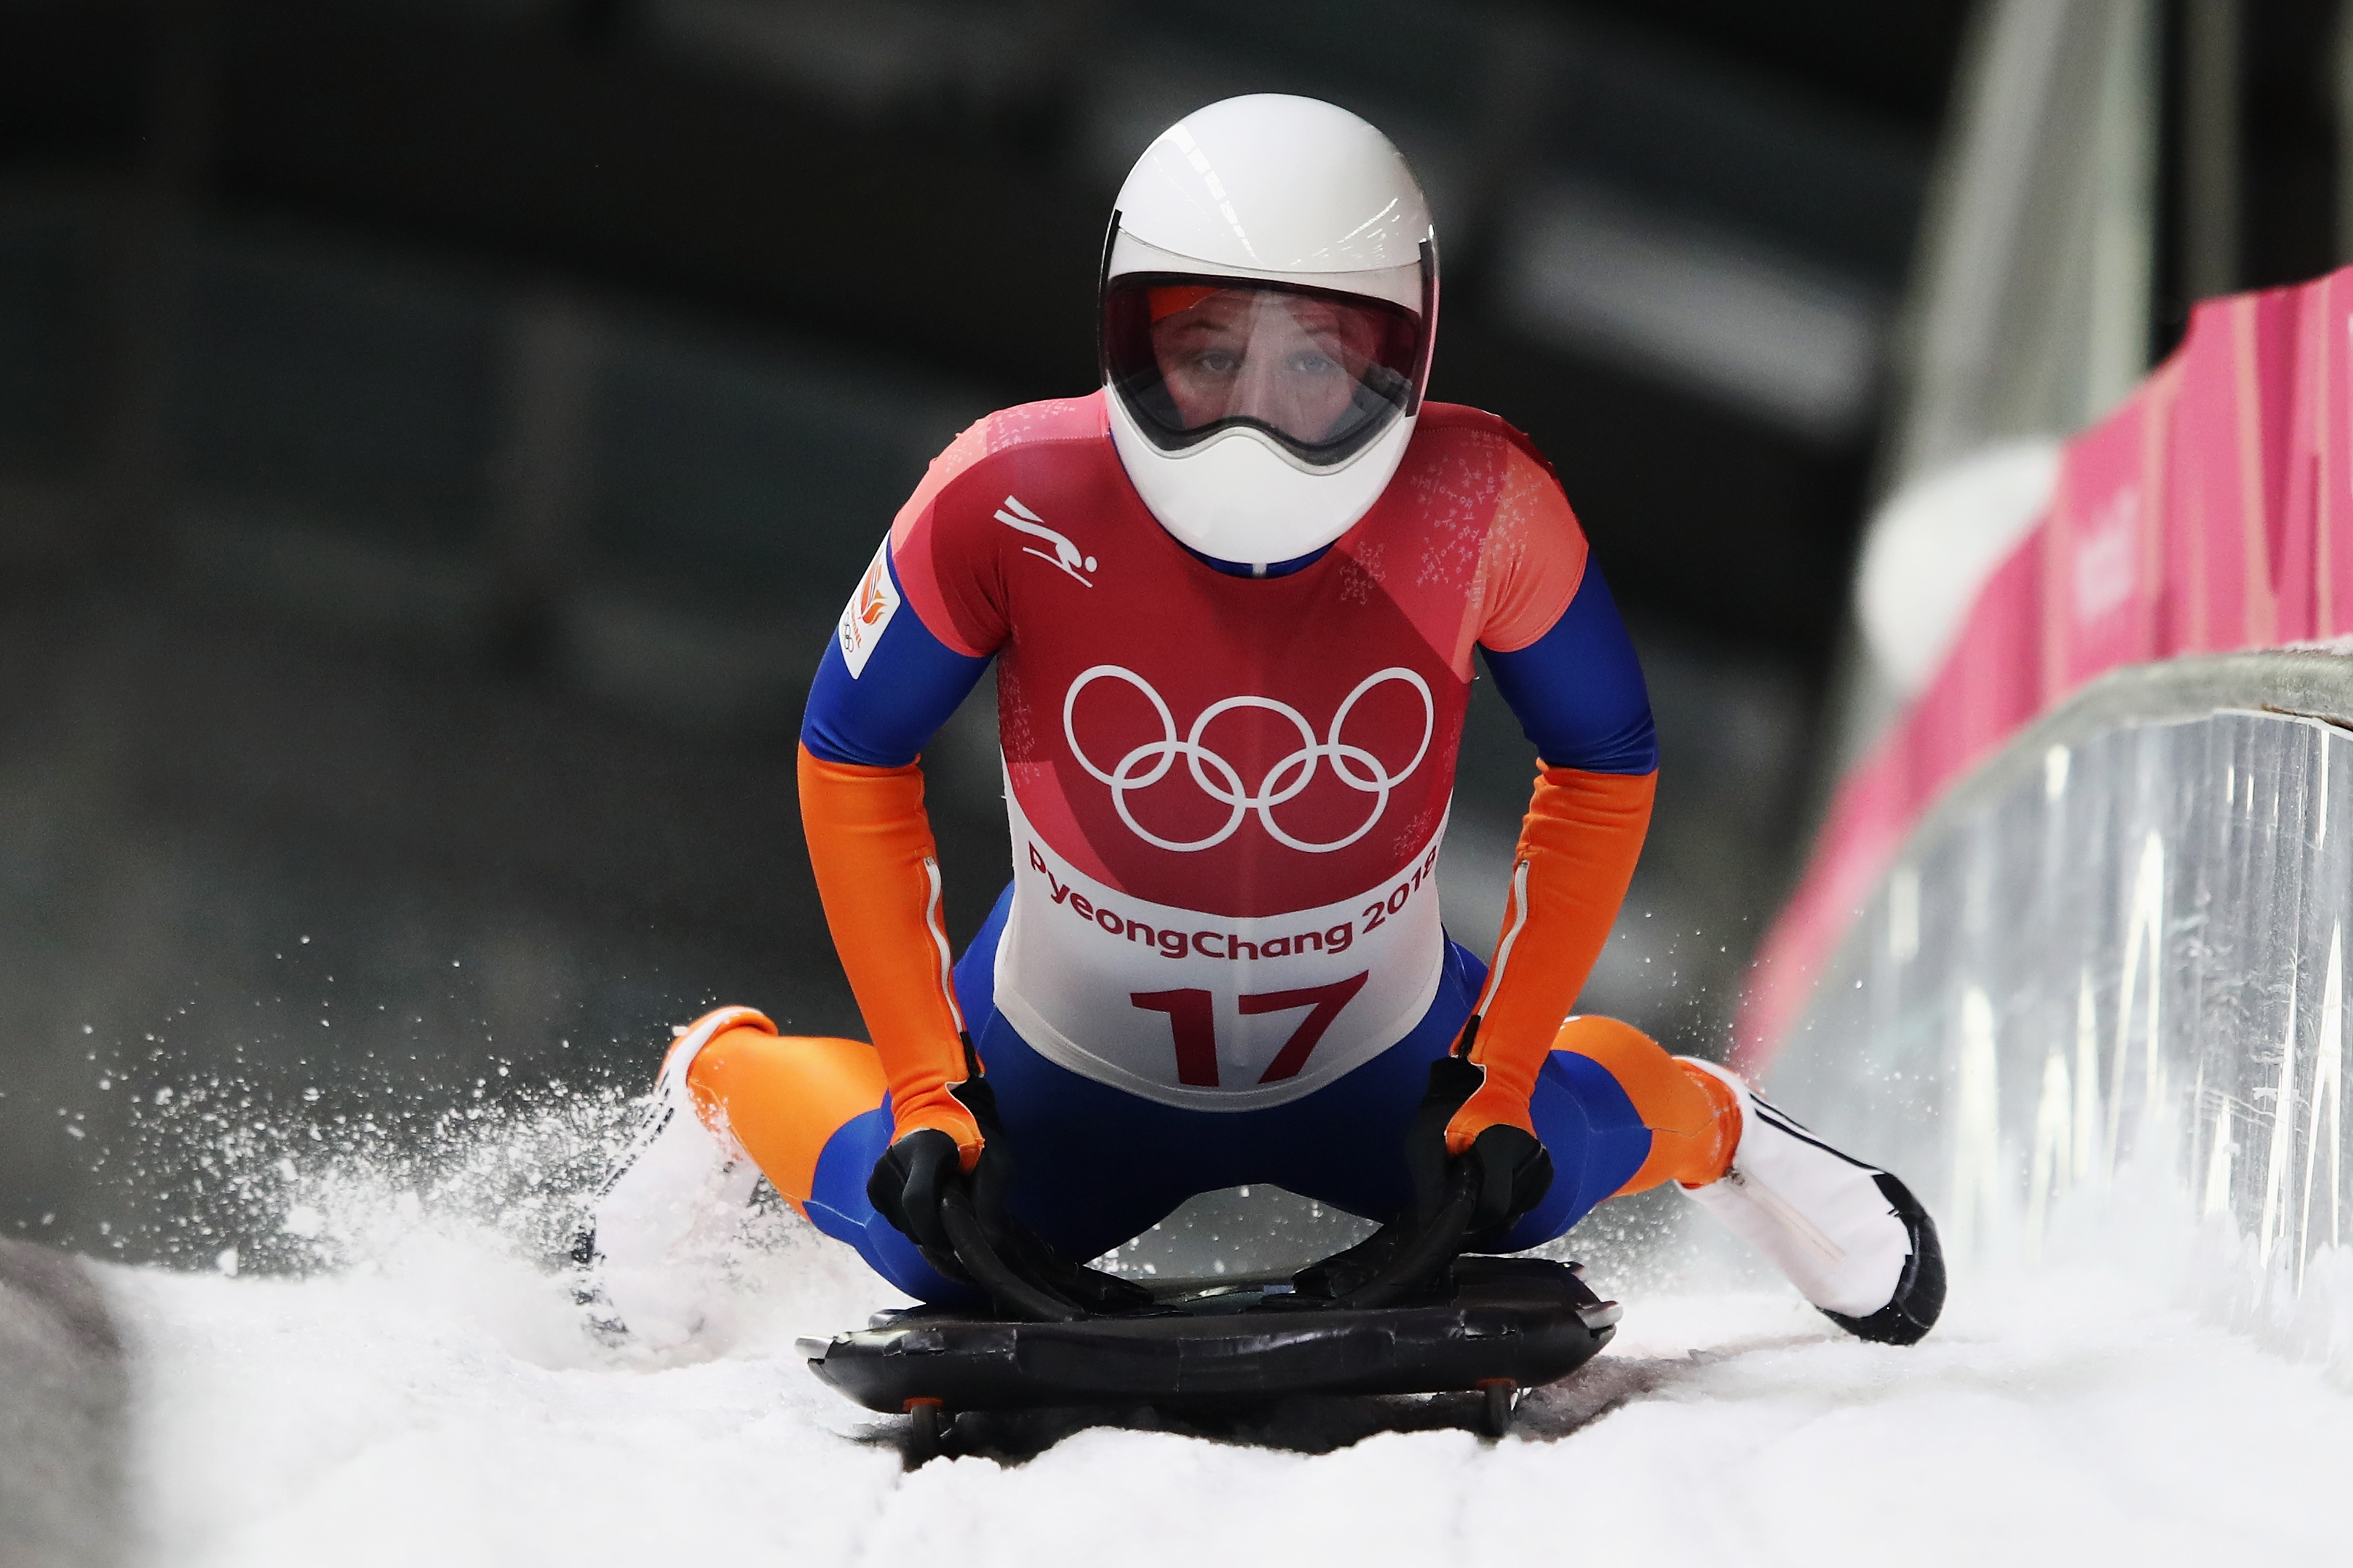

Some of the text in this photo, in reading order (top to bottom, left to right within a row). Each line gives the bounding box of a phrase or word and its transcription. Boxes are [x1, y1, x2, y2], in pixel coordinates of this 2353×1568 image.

[1028, 840, 1437, 960] PyeongChang 2018
[1130, 969, 1369, 1087] 17
